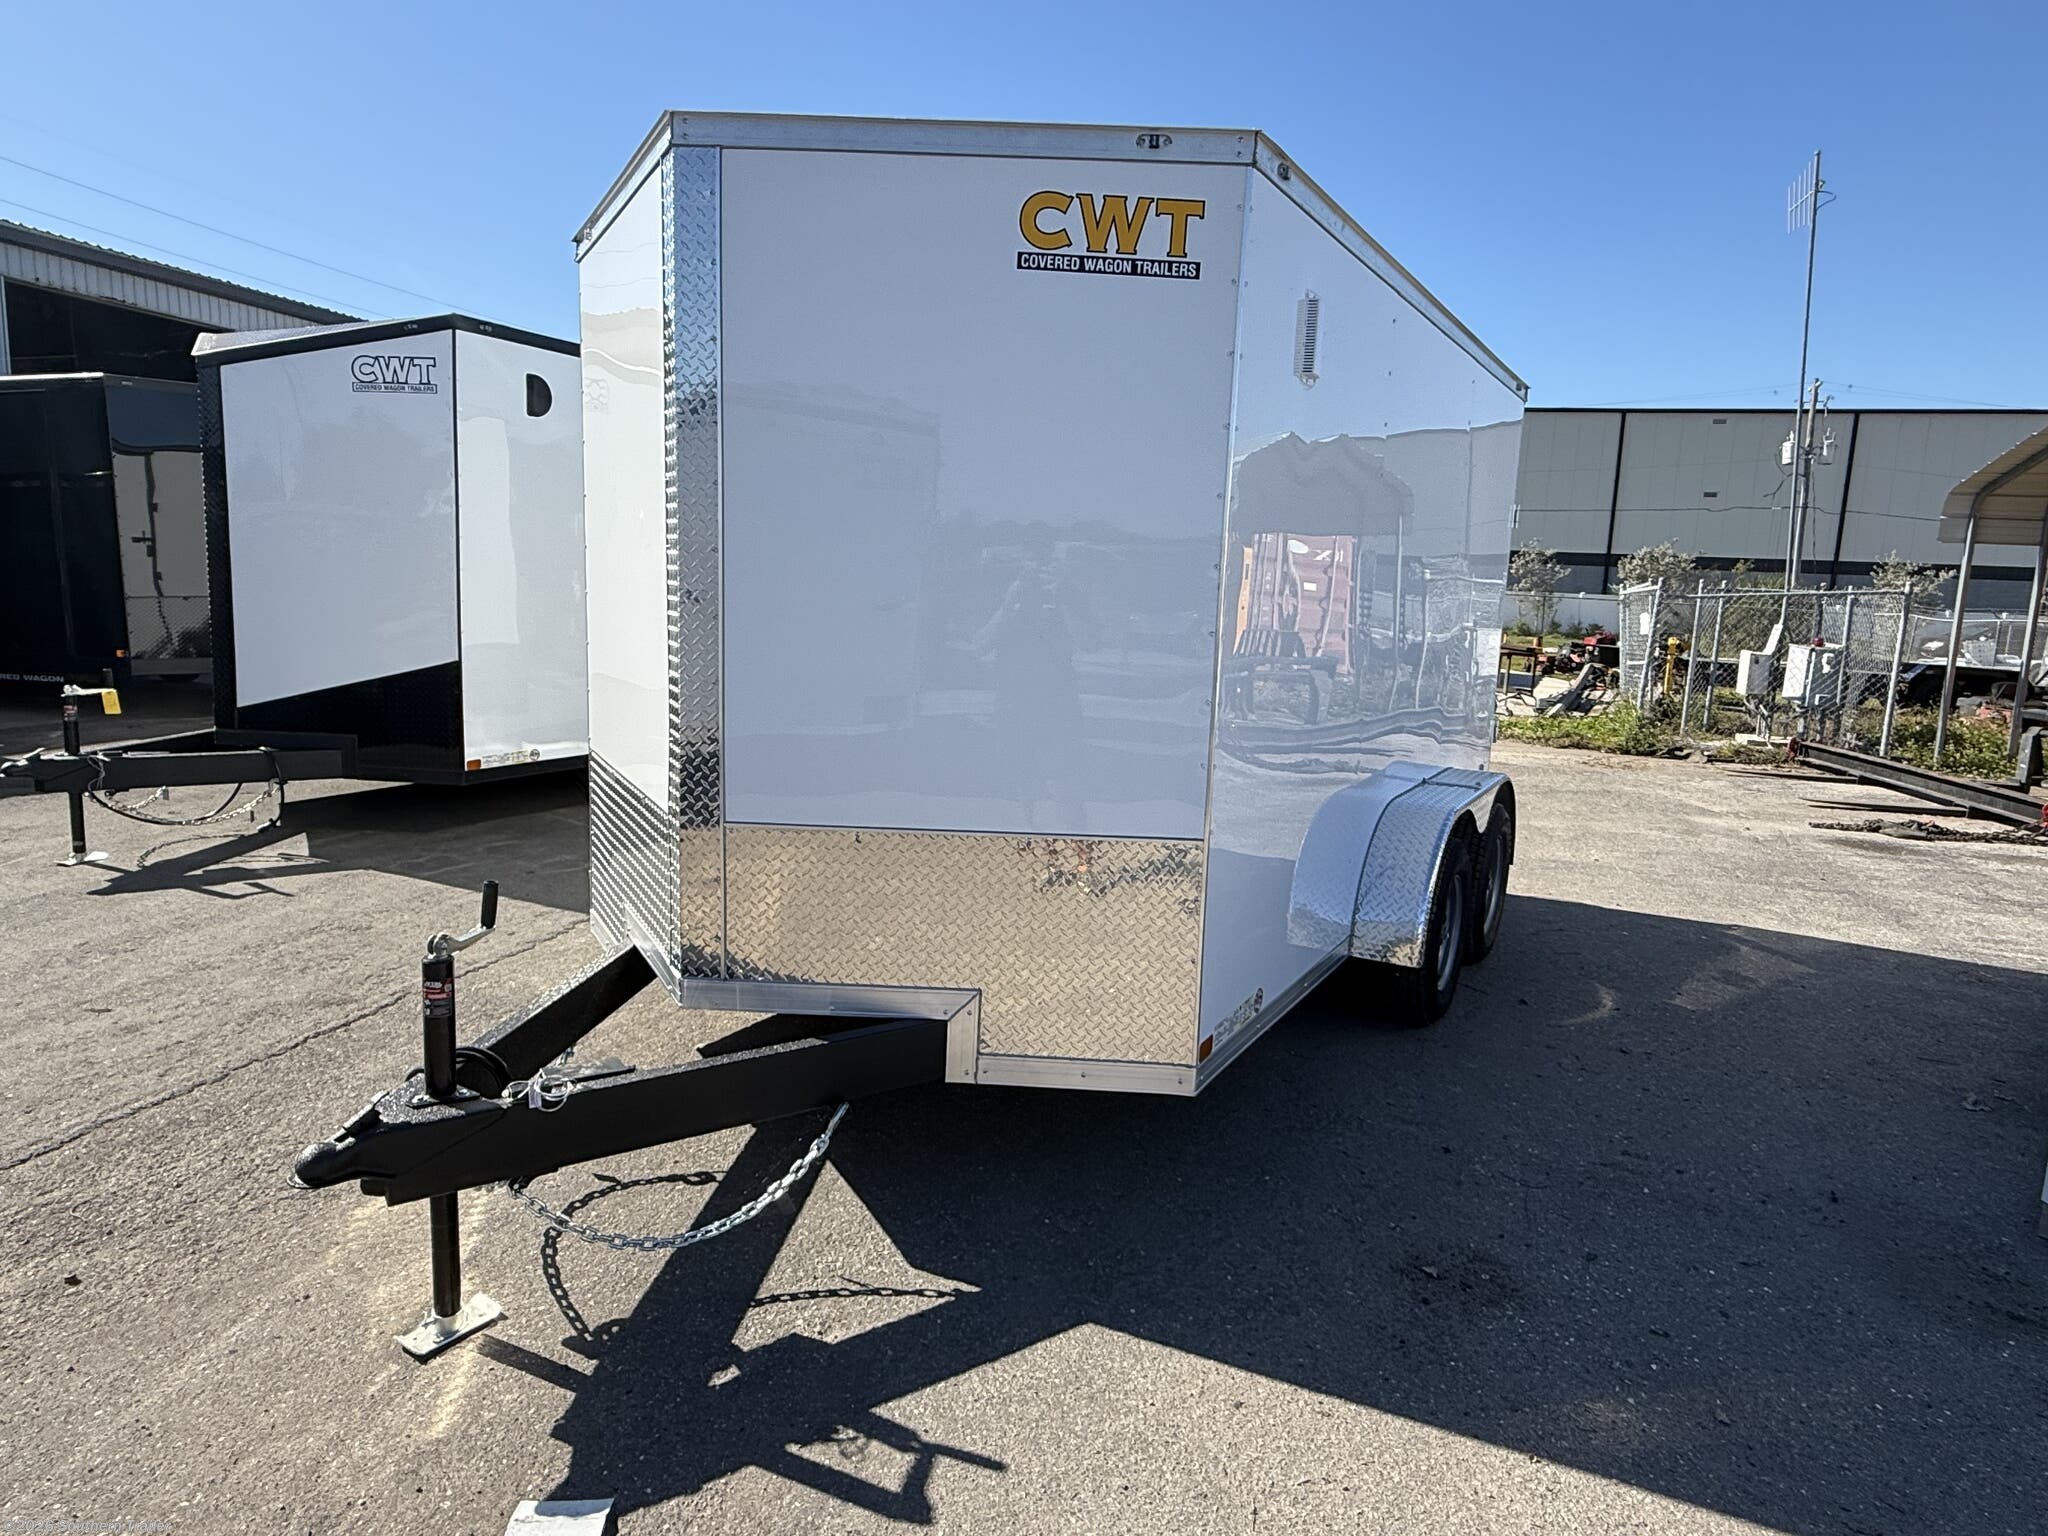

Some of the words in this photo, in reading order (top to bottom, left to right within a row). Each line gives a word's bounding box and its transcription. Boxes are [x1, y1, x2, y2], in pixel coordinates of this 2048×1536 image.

[1019, 190, 1206, 258] CWT
[1020, 253, 1080, 271] COVERED
[1083, 257, 1132, 274] WAGON
[1135, 260, 1197, 278] TRAILERS
[351, 354, 437, 385] CWT
[355, 383, 383, 391] COVERED
[23, 674, 64, 683] WAGON
